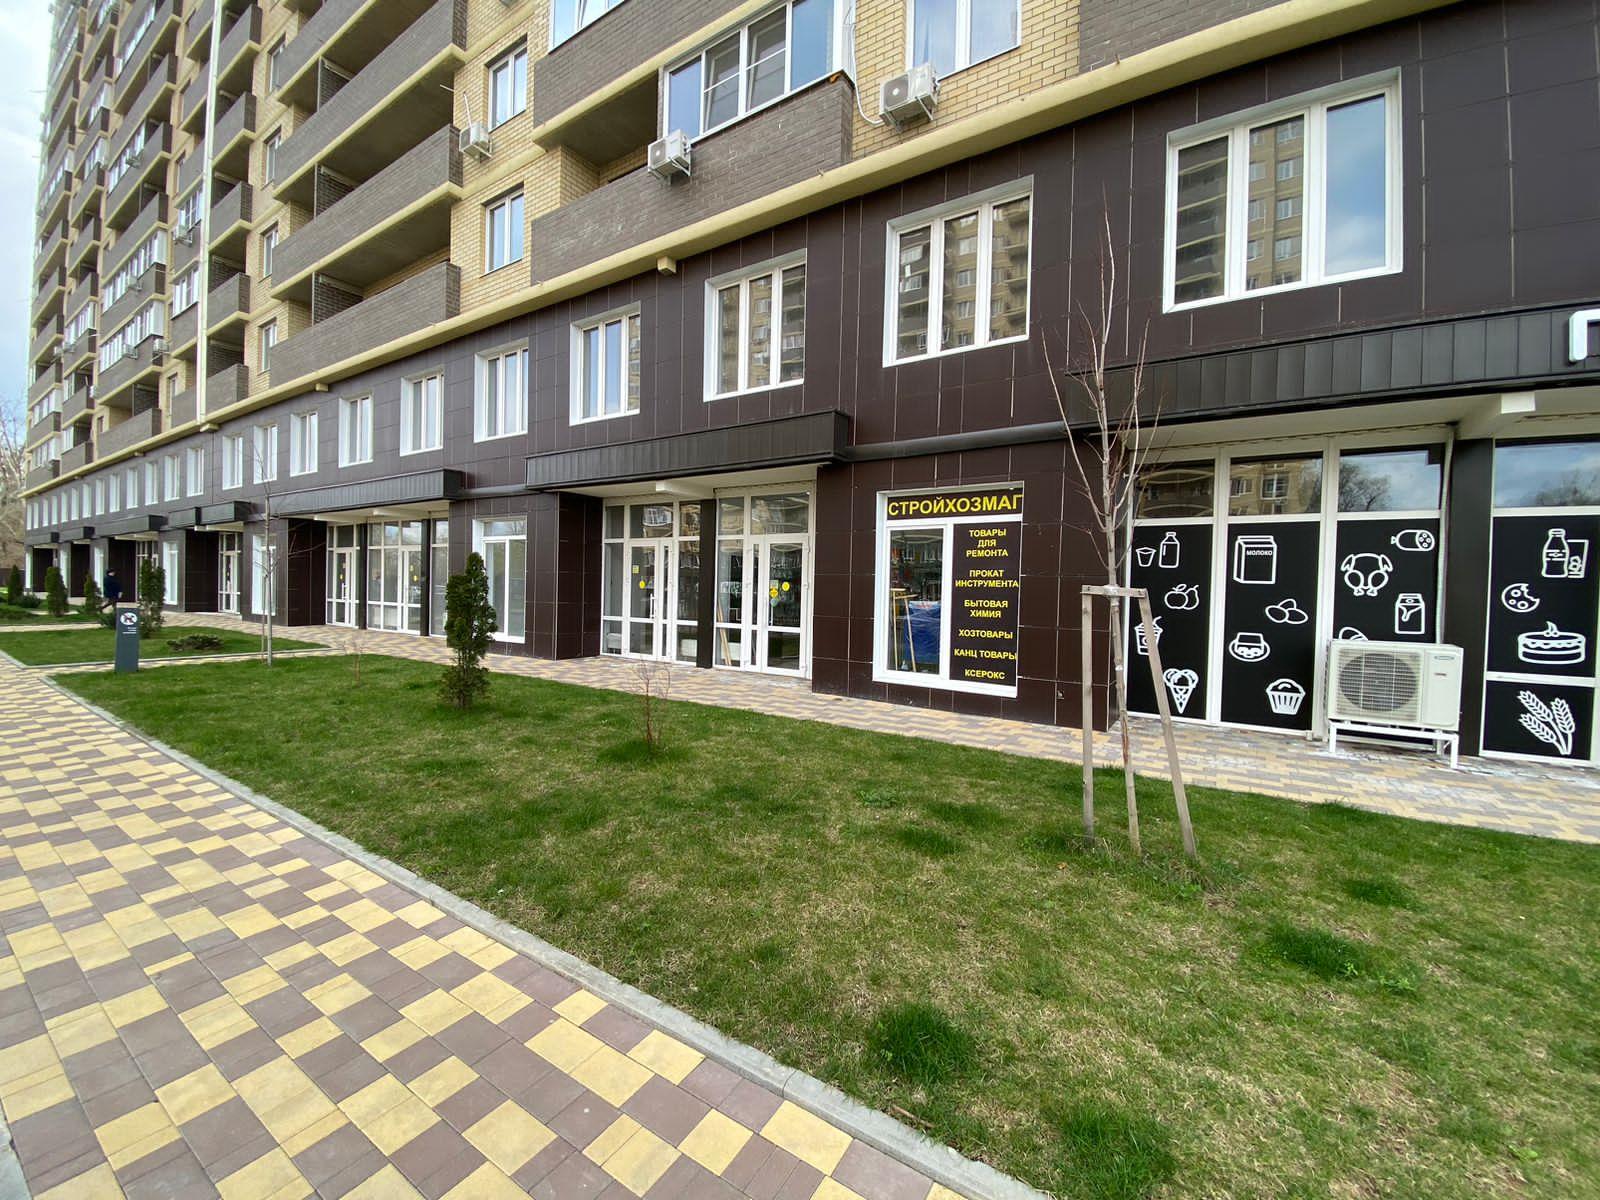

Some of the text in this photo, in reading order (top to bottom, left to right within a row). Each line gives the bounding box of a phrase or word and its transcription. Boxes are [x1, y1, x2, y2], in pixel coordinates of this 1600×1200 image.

[888, 494, 1023, 515] СТРОЙХОЗМАГ
[969, 528, 1007, 538] ТОВАРЫ
[977, 539, 997, 548] ДЛЯ
[966, 549, 1009, 558] РЕМОНТА
[969, 569, 1005, 578] ПРОКАТ
[955, 579, 1020, 588] ИНСТРУМЕНТА
[964, 599, 1009, 609] БЫТОВАЯ
[970, 609, 1002, 619] ХИМИЯ
[958, 629, 1013, 639] ХОЗТОВАРЫ
[954, 648, 1018, 660] КАНЦ ТОВАРЫ
[964, 669, 1005, 680] КСЕРОКС
